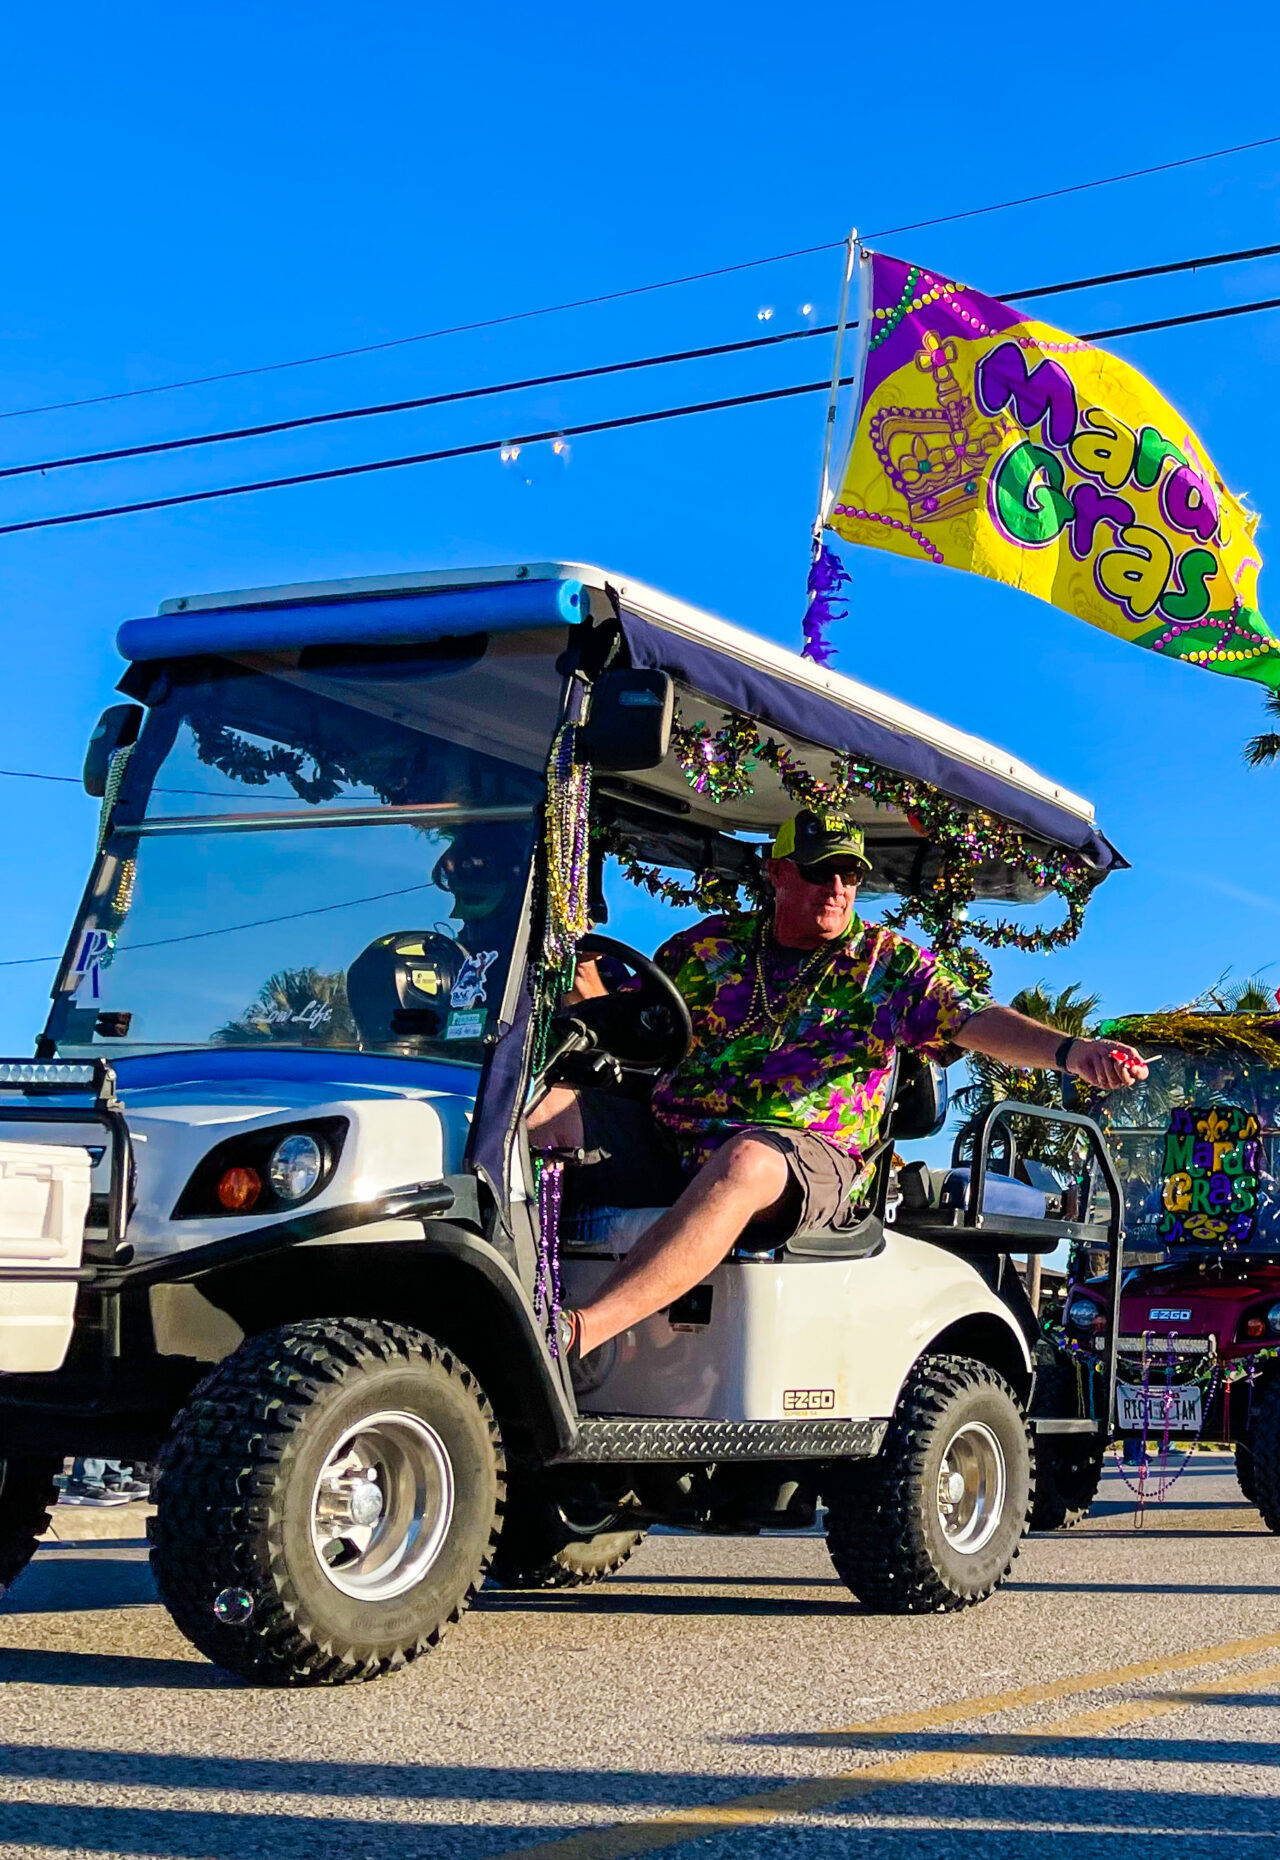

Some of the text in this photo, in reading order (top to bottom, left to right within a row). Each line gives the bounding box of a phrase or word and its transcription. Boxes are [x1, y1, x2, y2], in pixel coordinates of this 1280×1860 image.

[987, 438, 1219, 624] Gras
[291, 1000, 333, 1030] Life
[1150, 1310, 1190, 1320] EZGO
[784, 1390, 834, 1409] EZGO
[1123, 1399, 1153, 1420] RICH
[1174, 1400, 1197, 1421] TAM
